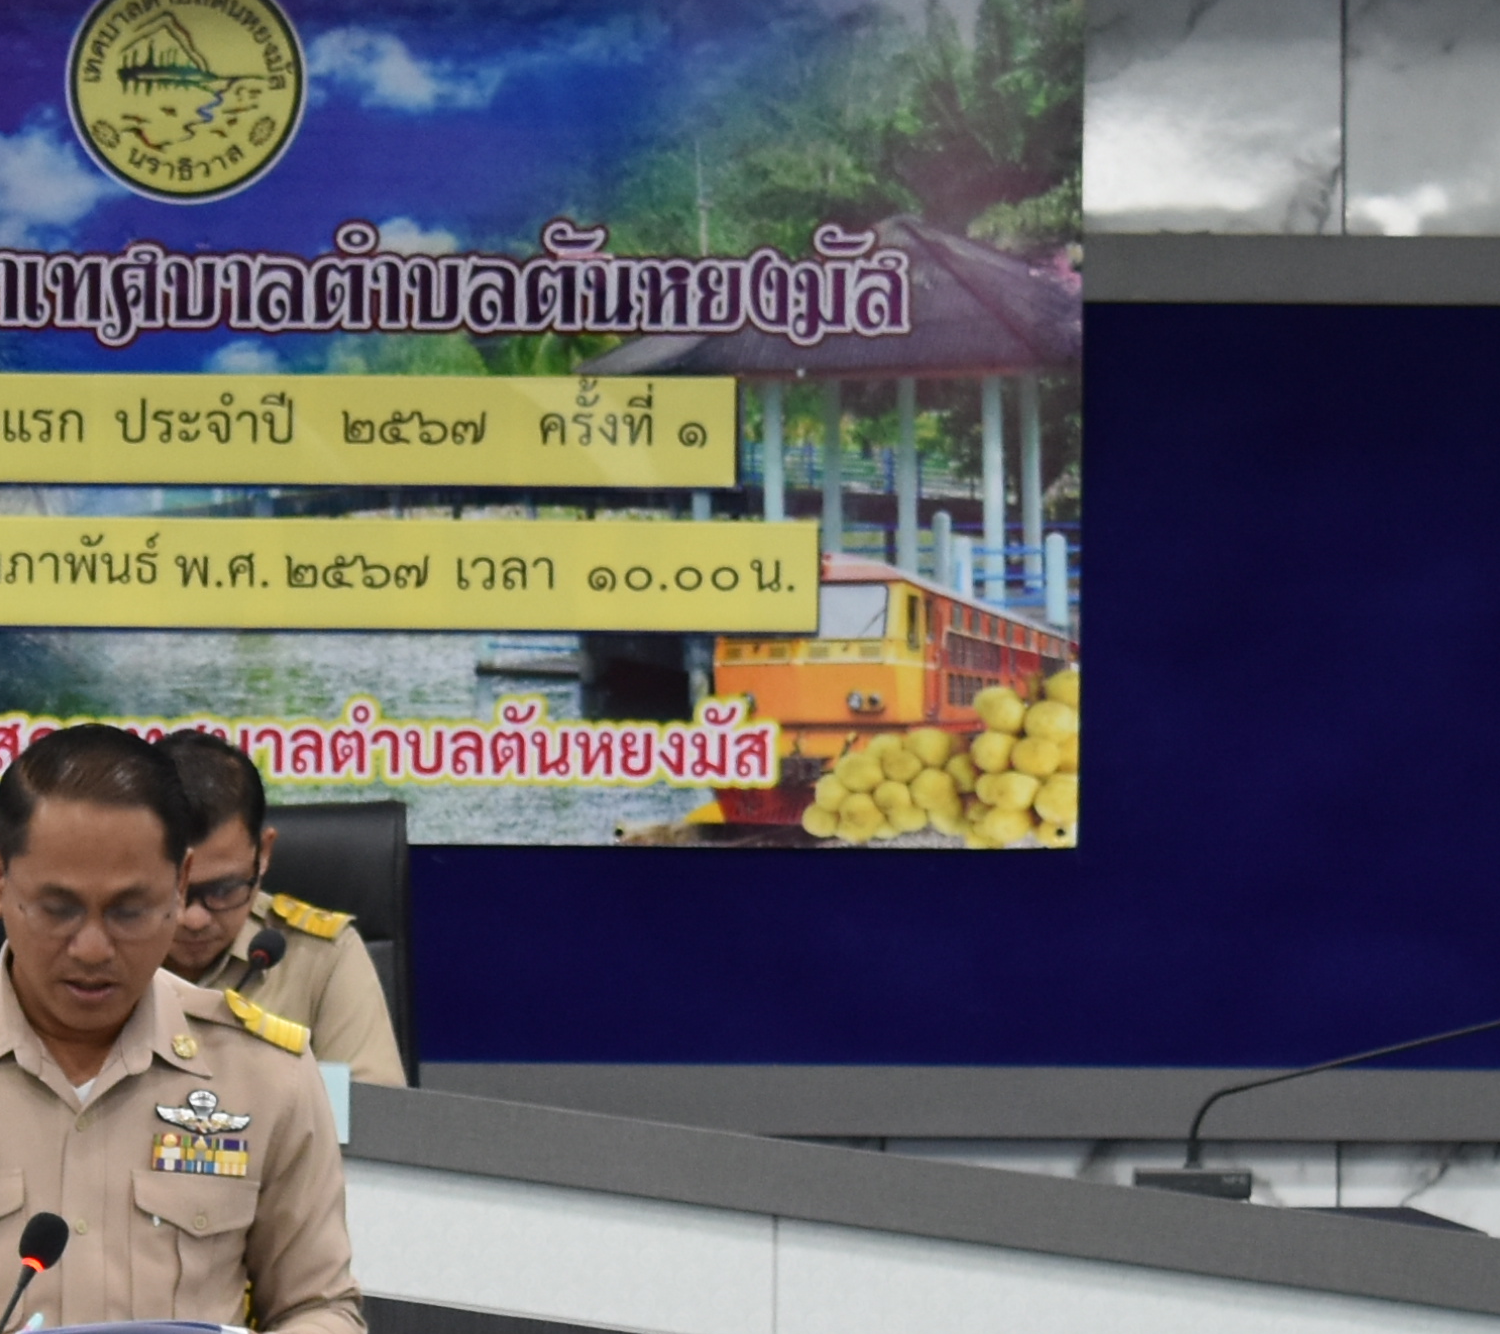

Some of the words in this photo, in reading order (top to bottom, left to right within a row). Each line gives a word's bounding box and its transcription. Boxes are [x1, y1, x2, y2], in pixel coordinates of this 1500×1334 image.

[127, 143, 244, 182] นราธิวาส
[115, 392, 295, 446] ประจำปี
[341, 410, 488, 447] ๒๕๖๗
[539, 376, 656, 447] ครั้งที่
[677, 420, 709, 449] ๑
[286, 554, 430, 591] ๒๕๖๗
[457, 556, 556, 592] เวลา
